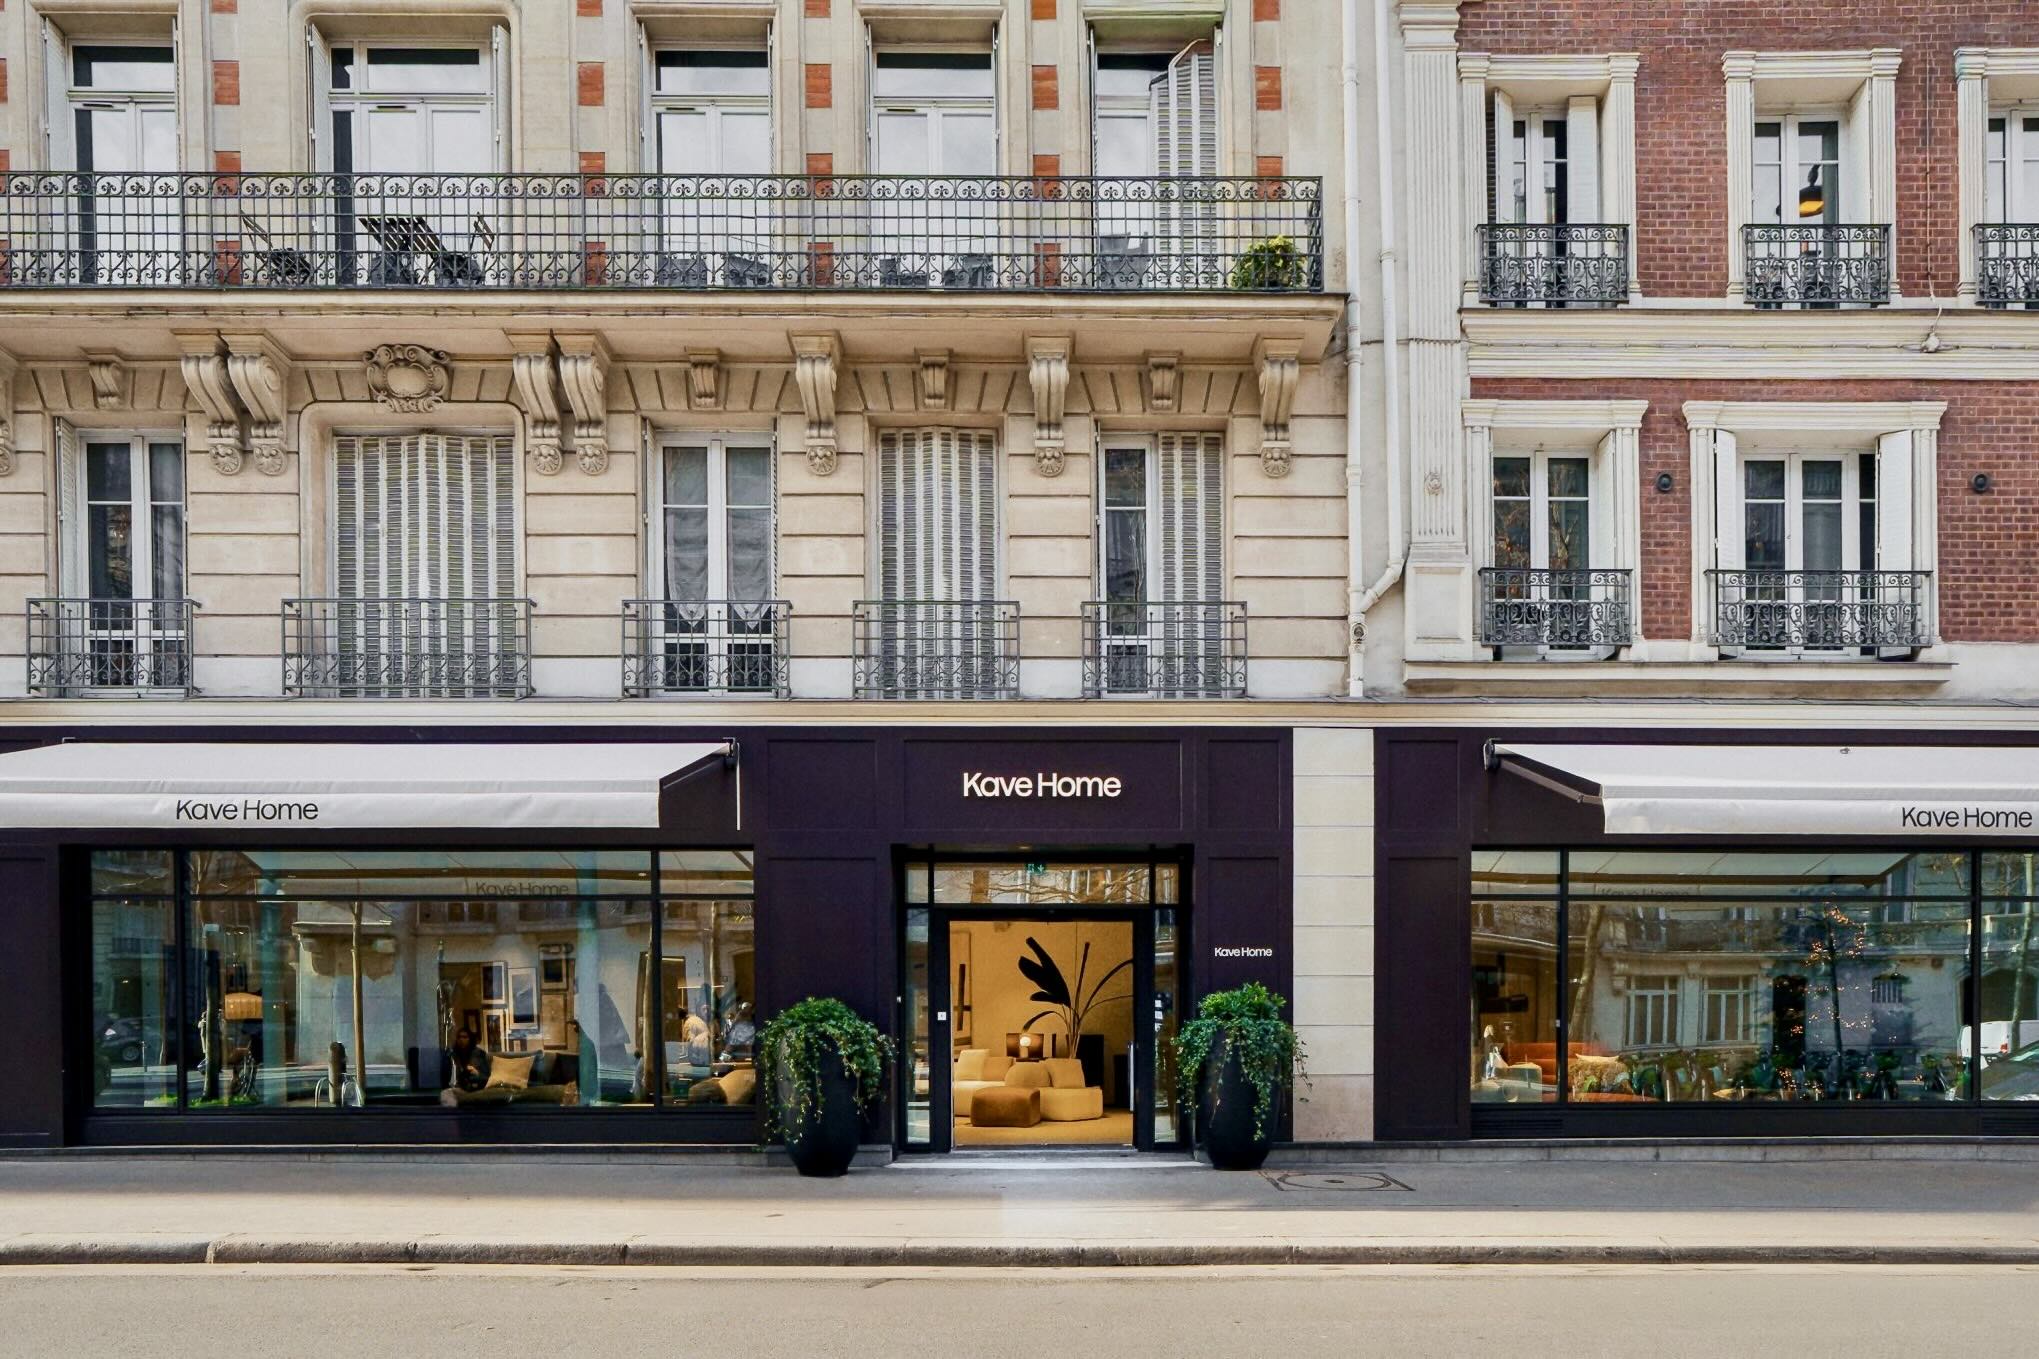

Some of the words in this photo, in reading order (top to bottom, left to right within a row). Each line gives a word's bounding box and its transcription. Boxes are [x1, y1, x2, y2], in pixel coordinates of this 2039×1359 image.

[963, 772, 1033, 797] Kave
[1037, 772, 1122, 797] Home
[176, 799, 238, 820] Kave
[243, 799, 319, 820] Home
[1901, 806, 1960, 828] Kave
[1963, 807, 2033, 828] Home
[1214, 947, 1240, 957] Kave
[1241, 946, 1273, 957] Home
